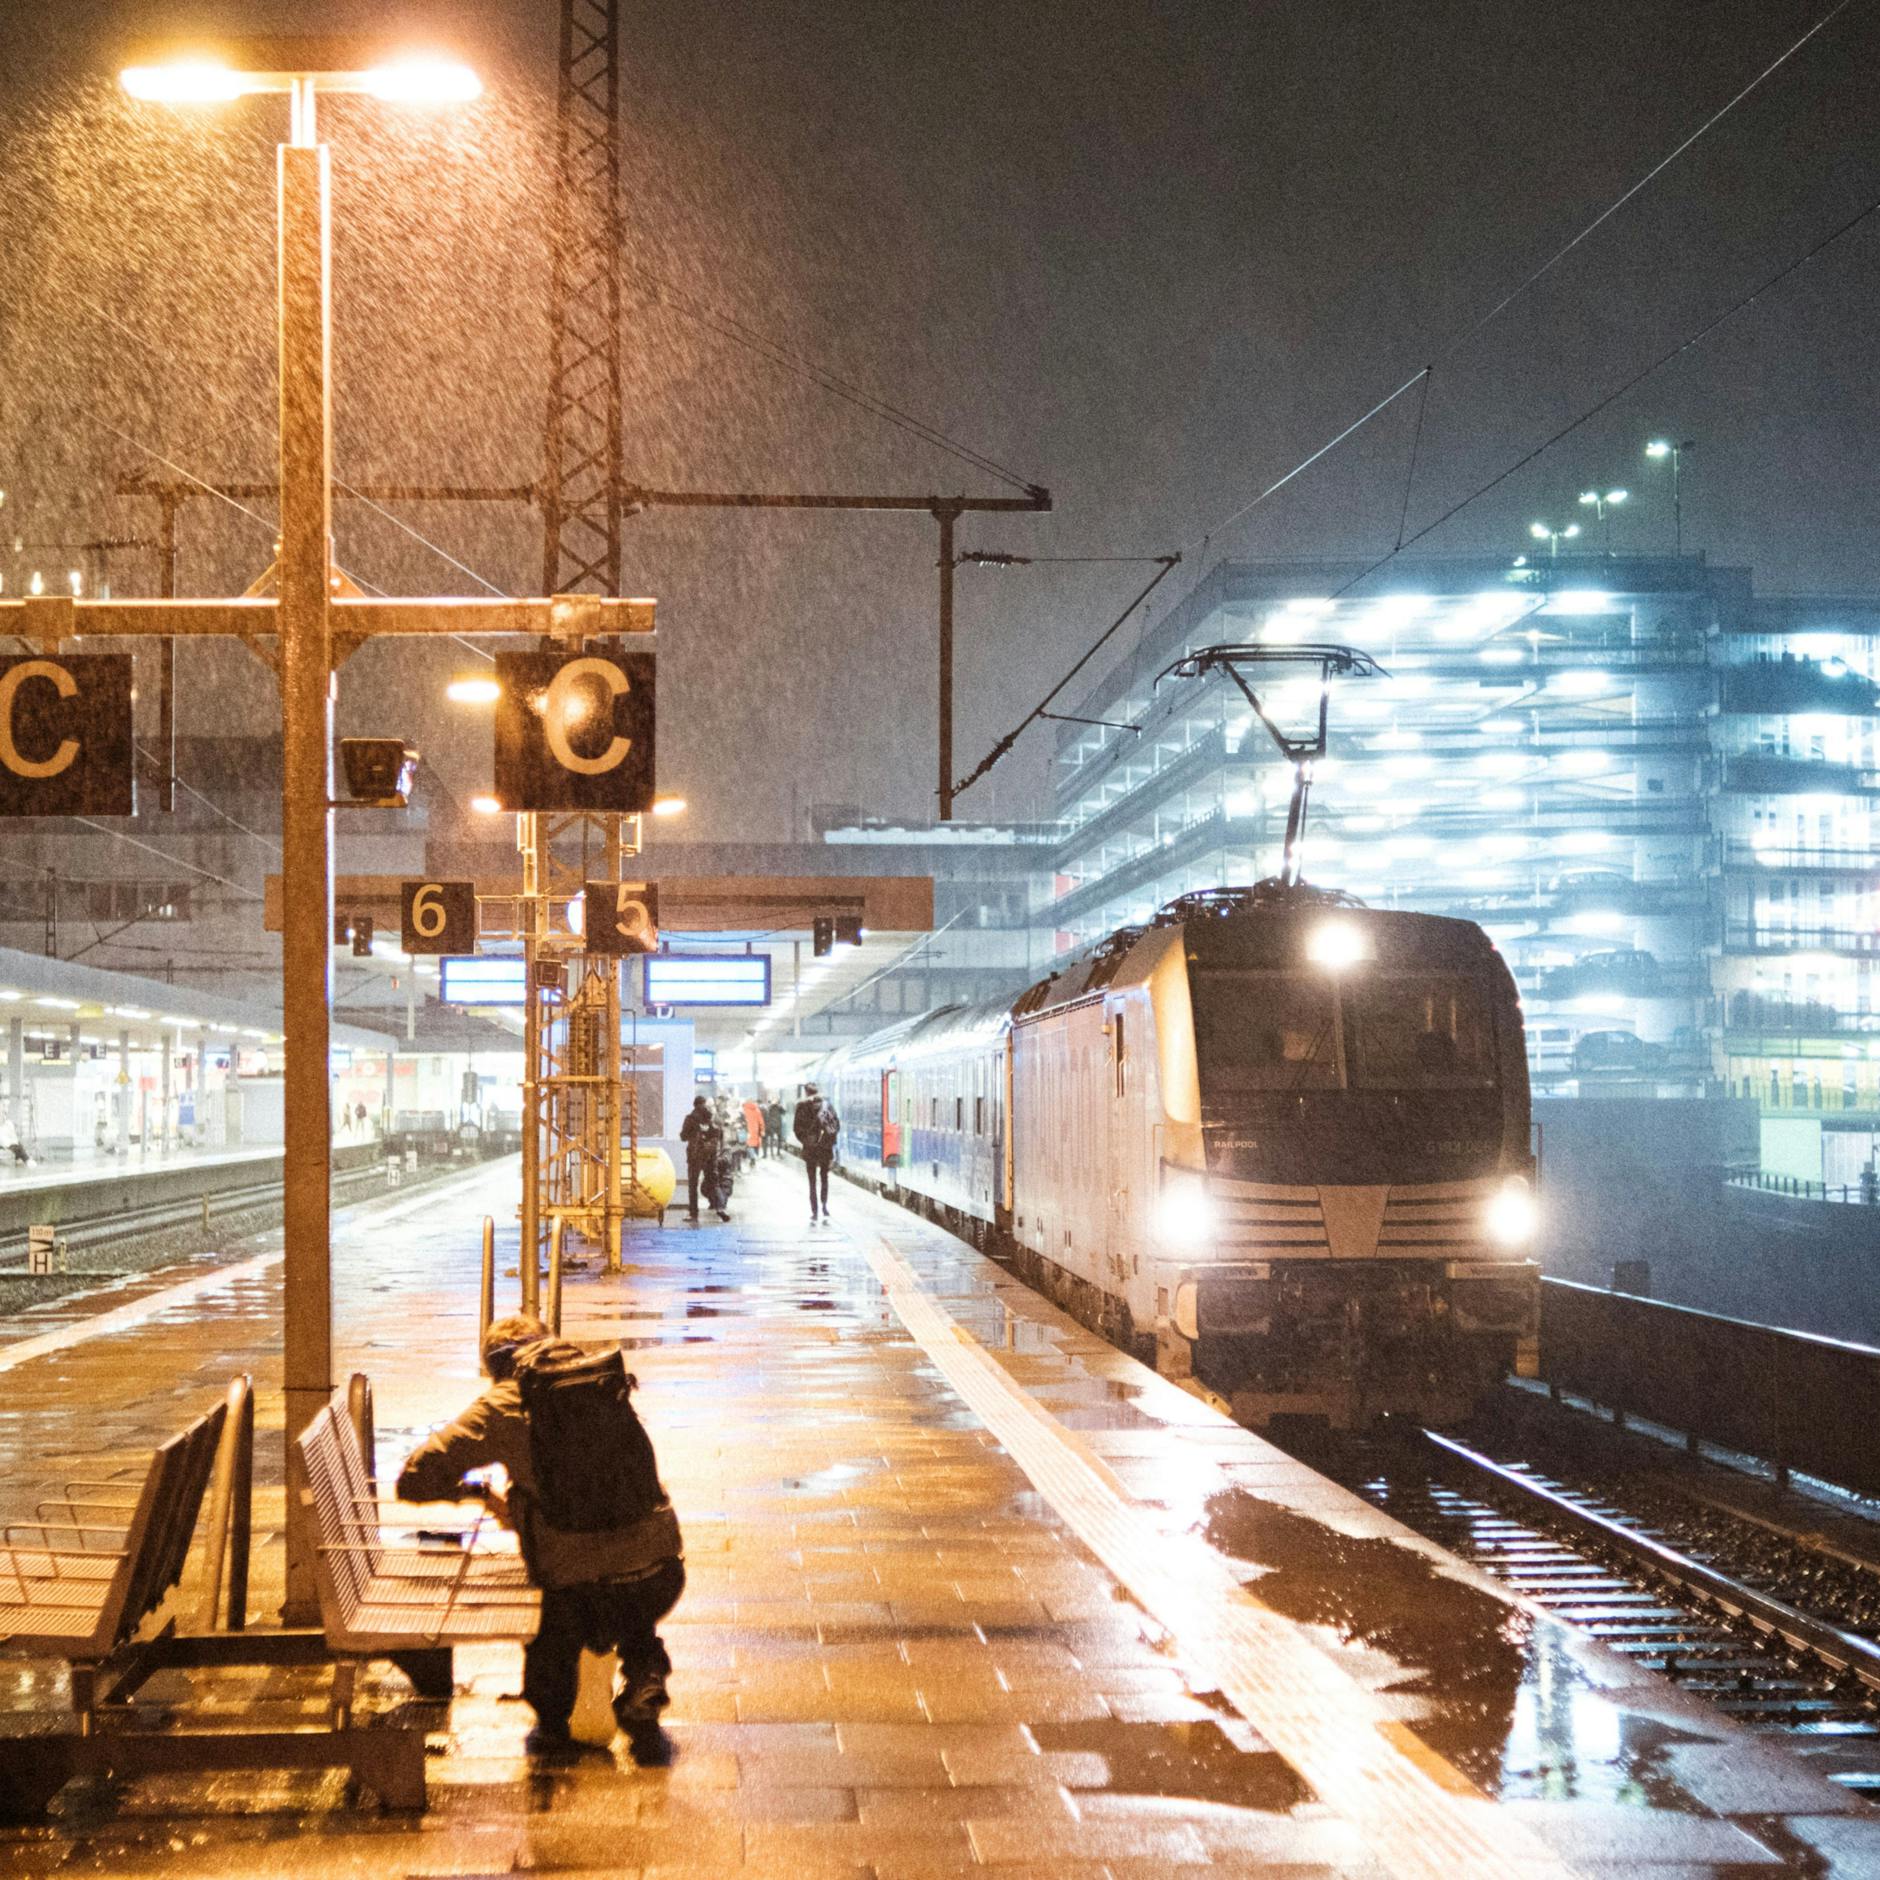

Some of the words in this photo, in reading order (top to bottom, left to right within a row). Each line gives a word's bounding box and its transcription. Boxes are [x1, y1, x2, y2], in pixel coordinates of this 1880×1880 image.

[0, 660, 80, 778] C
[547, 658, 632, 775] C
[411, 883, 447, 937] 6
[615, 883, 649, 936] 5
[45, 1042, 55, 1058] E
[1214, 1140, 1259, 1149] RAILPOOL
[34, 1254, 48, 1273] H
